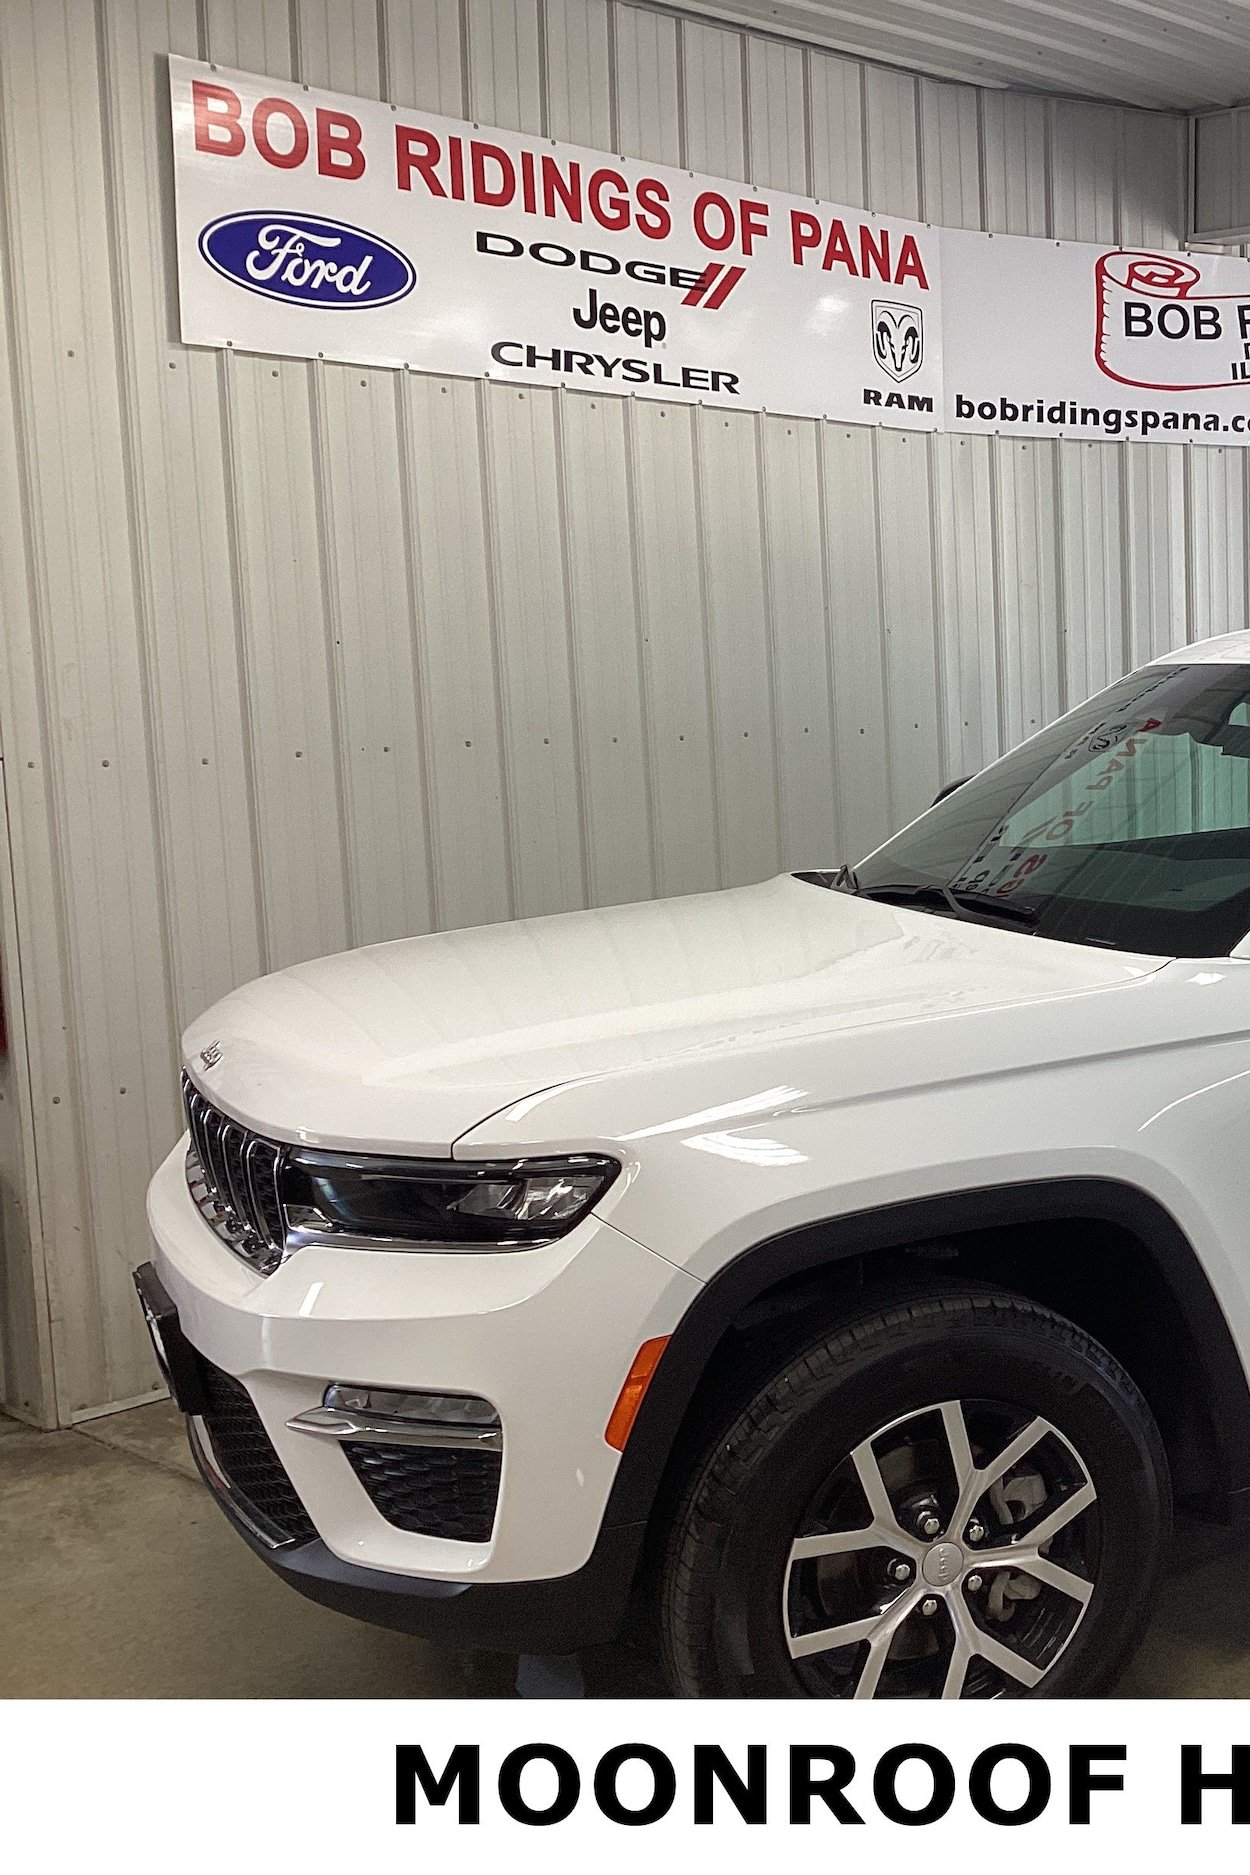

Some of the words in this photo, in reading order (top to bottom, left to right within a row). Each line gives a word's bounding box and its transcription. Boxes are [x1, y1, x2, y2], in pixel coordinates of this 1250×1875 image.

[191, 80, 366, 180] BOB
[396, 124, 671, 240] RIDINGS
[693, 191, 769, 257] OF
[790, 210, 928, 290] PANA
[246, 224, 373, 295] Ford
[476, 231, 708, 292] DODGE
[573, 288, 666, 349] Jeep
[1124, 301, 1222, 340] BOB
[491, 341, 740, 395] CHRYSLER
[863, 388, 934, 413] RAM
